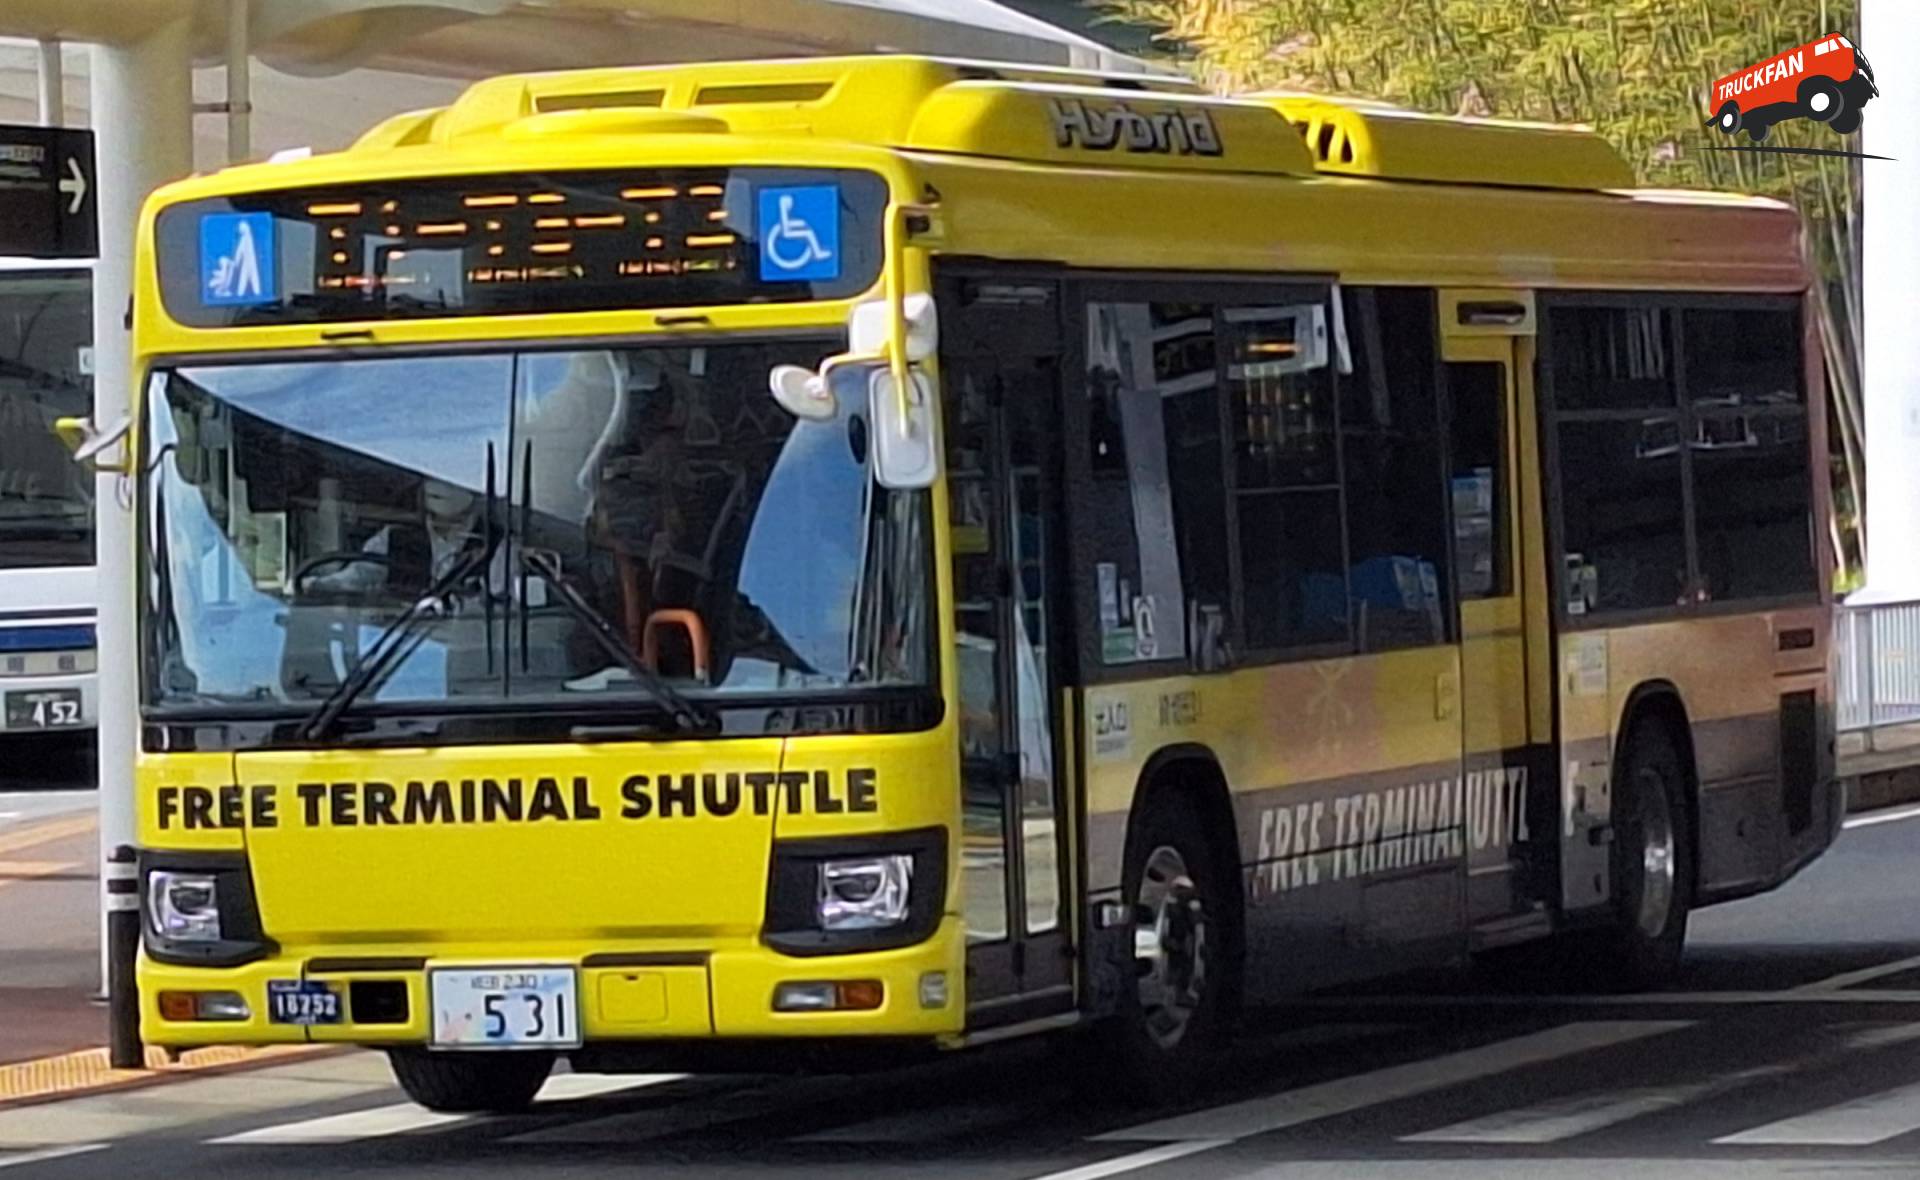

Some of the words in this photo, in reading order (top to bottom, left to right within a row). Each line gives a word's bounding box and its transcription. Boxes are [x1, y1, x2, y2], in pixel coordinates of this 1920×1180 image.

[1050, 97, 1224, 157] Hybrid
[156, 784, 279, 830] FREE
[296, 776, 601, 828] TERMINAL
[620, 768, 878, 820] SHUTTLE
[1251, 801, 1325, 898] FREE
[1332, 776, 1462, 882] TERMINAL
